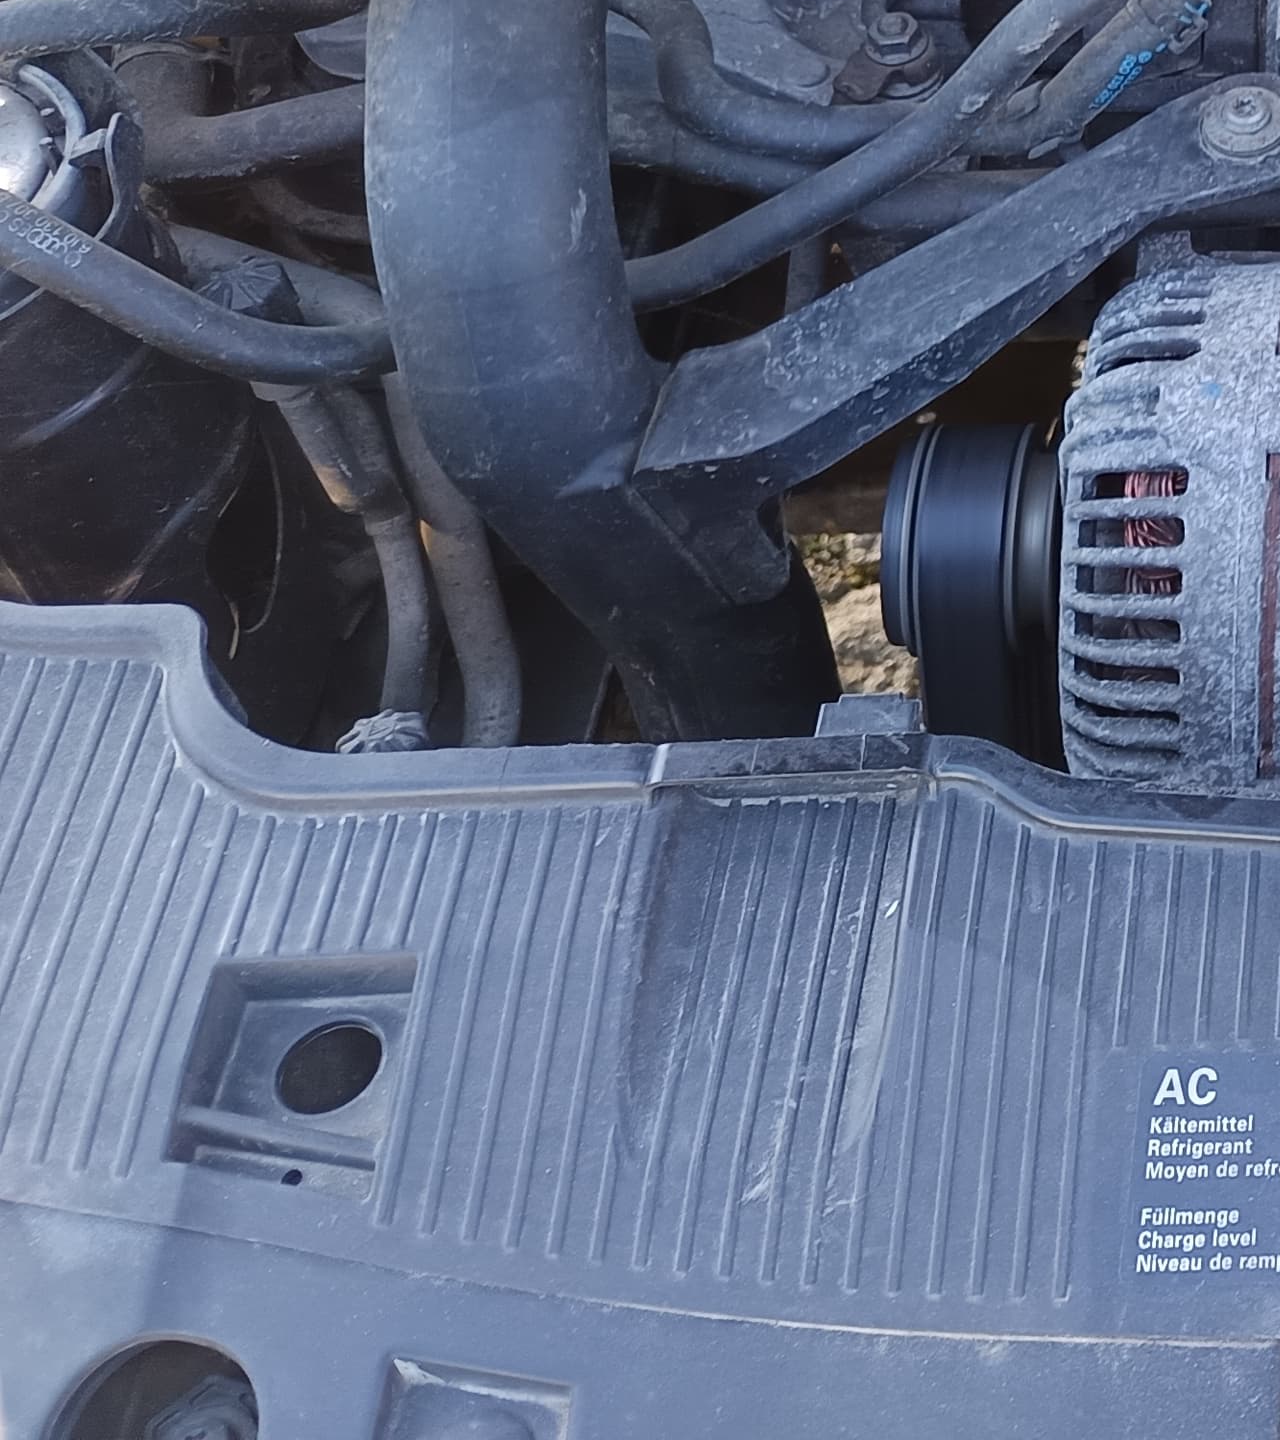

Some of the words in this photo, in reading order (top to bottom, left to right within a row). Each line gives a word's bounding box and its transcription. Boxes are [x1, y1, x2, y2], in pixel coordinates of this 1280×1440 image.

[1153, 1066, 1218, 1106] AC
[1150, 1115, 1254, 1135] Kältemittel
[1148, 1138, 1253, 1159] Refrigerant
[1145, 1161, 1209, 1183] Moyen
[1216, 1160, 1239, 1178] de
[1140, 1207, 1240, 1227] Füllmenge
[1138, 1230, 1205, 1252] Charge
[1212, 1228, 1257, 1247] level
[1136, 1254, 1201, 1273] Niveau
[1209, 1252, 1233, 1271] de
